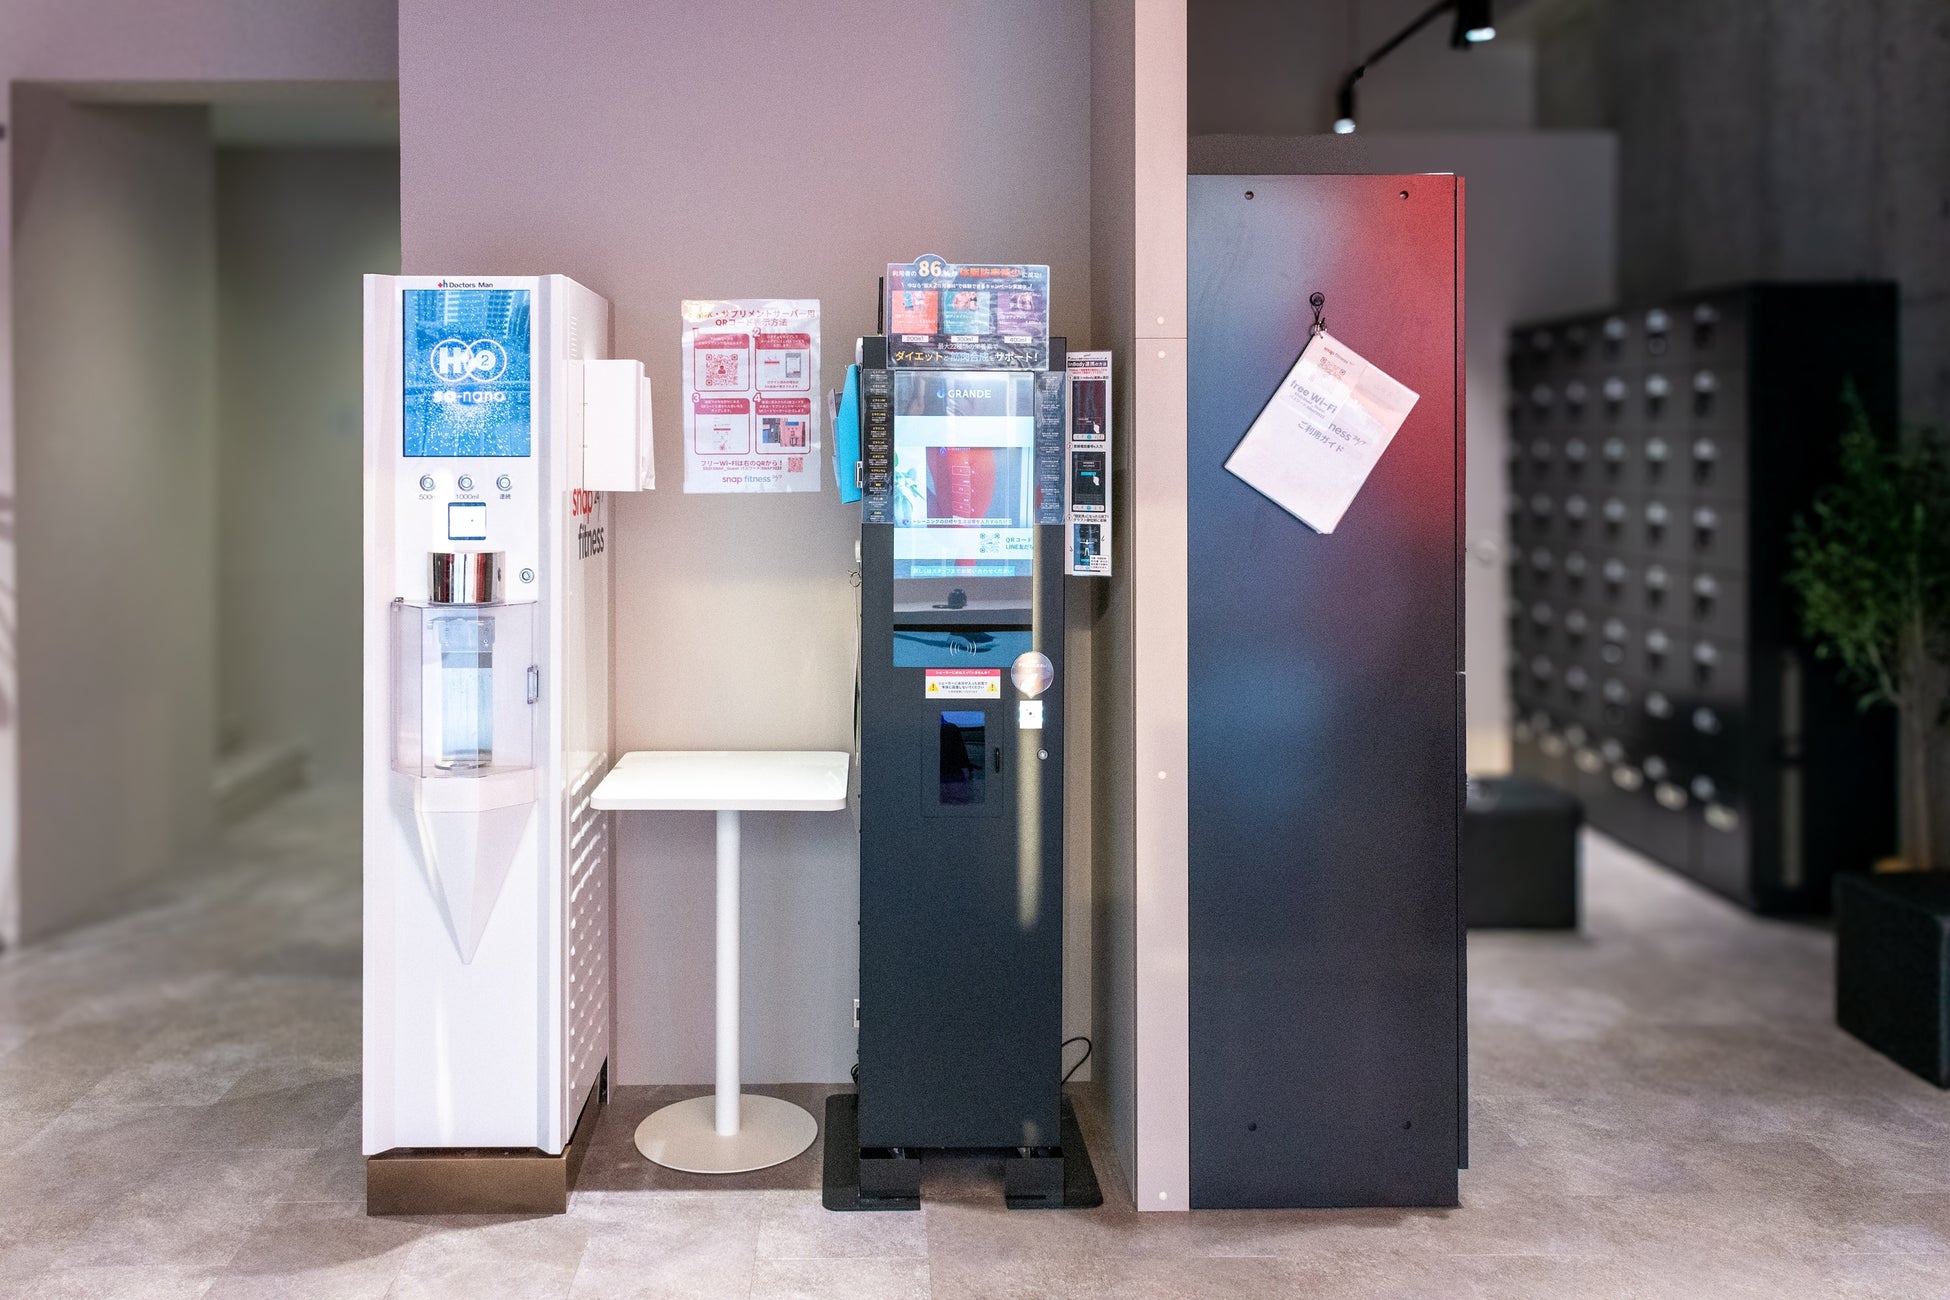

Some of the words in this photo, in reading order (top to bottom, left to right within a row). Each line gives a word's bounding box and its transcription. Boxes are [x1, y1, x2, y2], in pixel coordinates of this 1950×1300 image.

[692, 394, 700, 402] 3
[754, 394, 762, 402] 4
[948, 390, 992, 398] GRANDE
[1290, 380, 1310, 396] free
[1311, 392, 1338, 414] Wi-Fi
[1298, 420, 1345, 452] ご利用ガイド
[1328, 422, 1352, 441] ness
[722, 476, 742, 484] snap
[744, 474, 770, 482] fitness
[572, 488, 594, 524] snap
[578, 523, 605, 560] fitness
